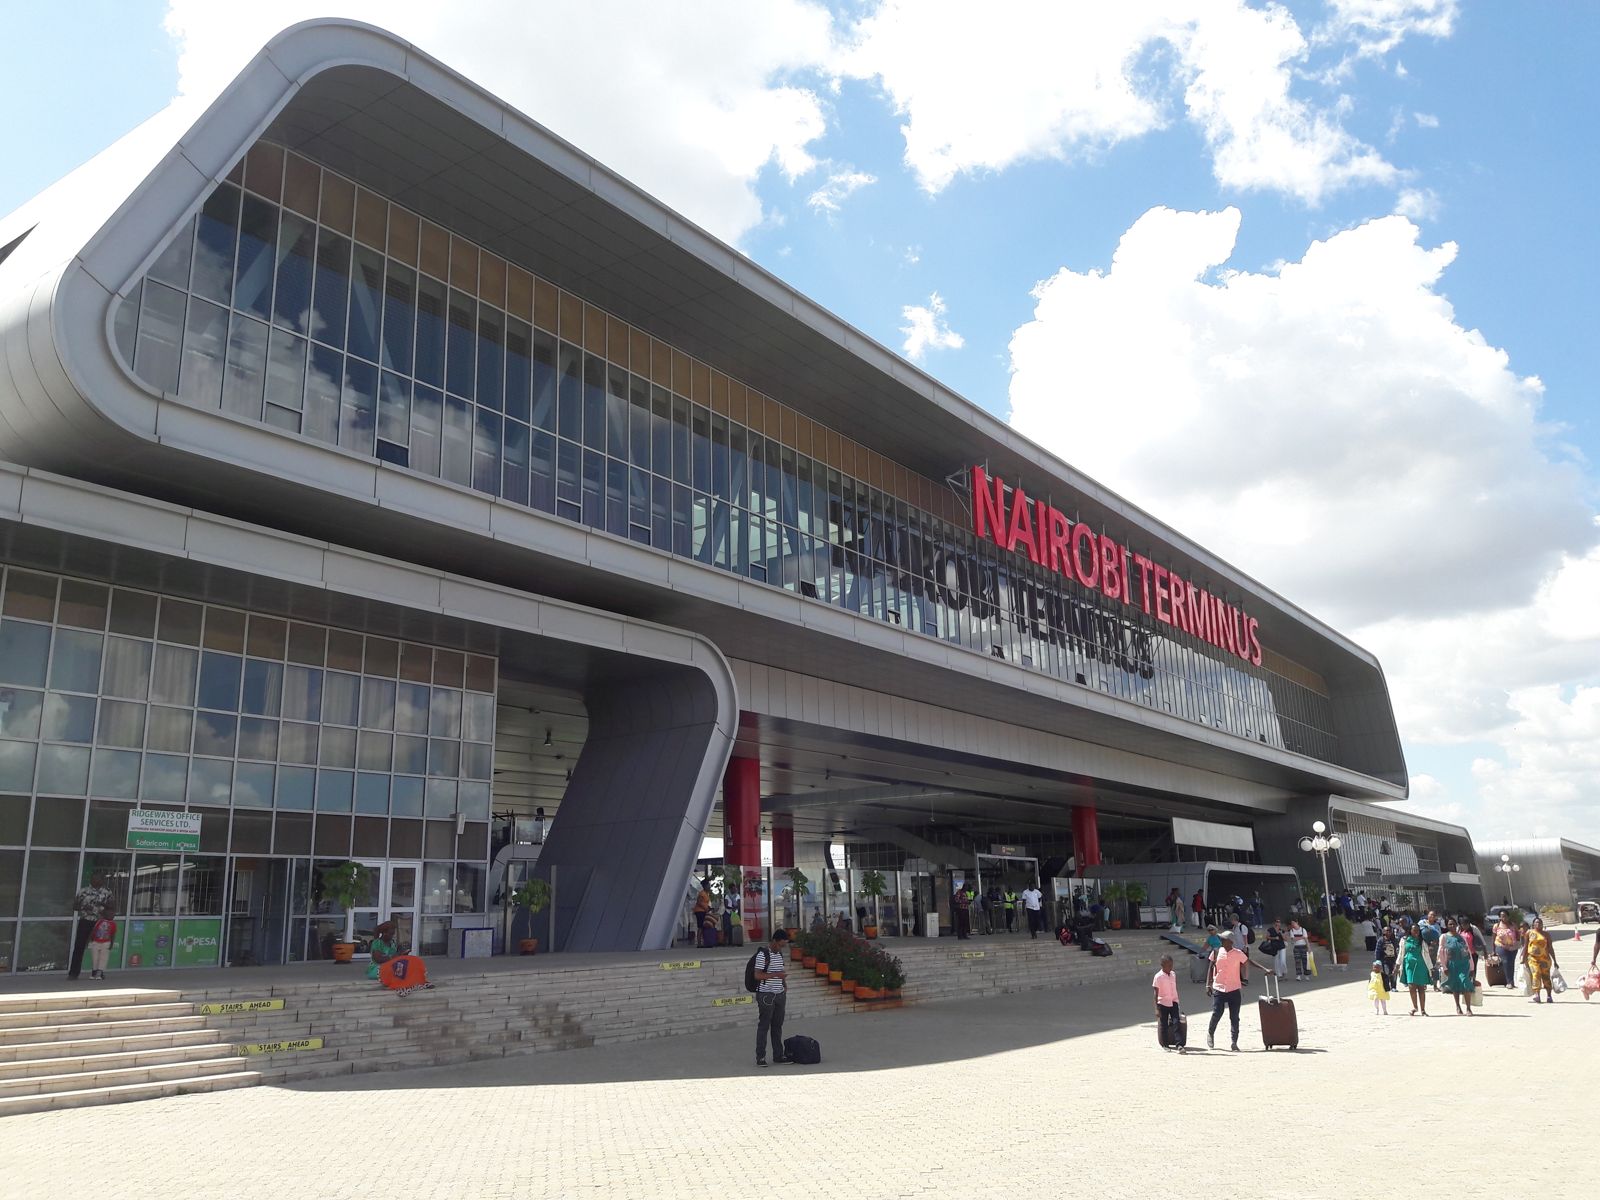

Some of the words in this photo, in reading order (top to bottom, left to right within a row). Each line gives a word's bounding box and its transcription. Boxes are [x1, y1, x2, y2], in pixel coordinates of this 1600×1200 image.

[970, 465, 1130, 605] NAIROBI
[1133, 553, 1262, 667] TERMINUS
[132, 809, 174, 820] RIDGEWAYS
[176, 812, 200, 821] OFFICE
[141, 819, 173, 827] SERVICES
